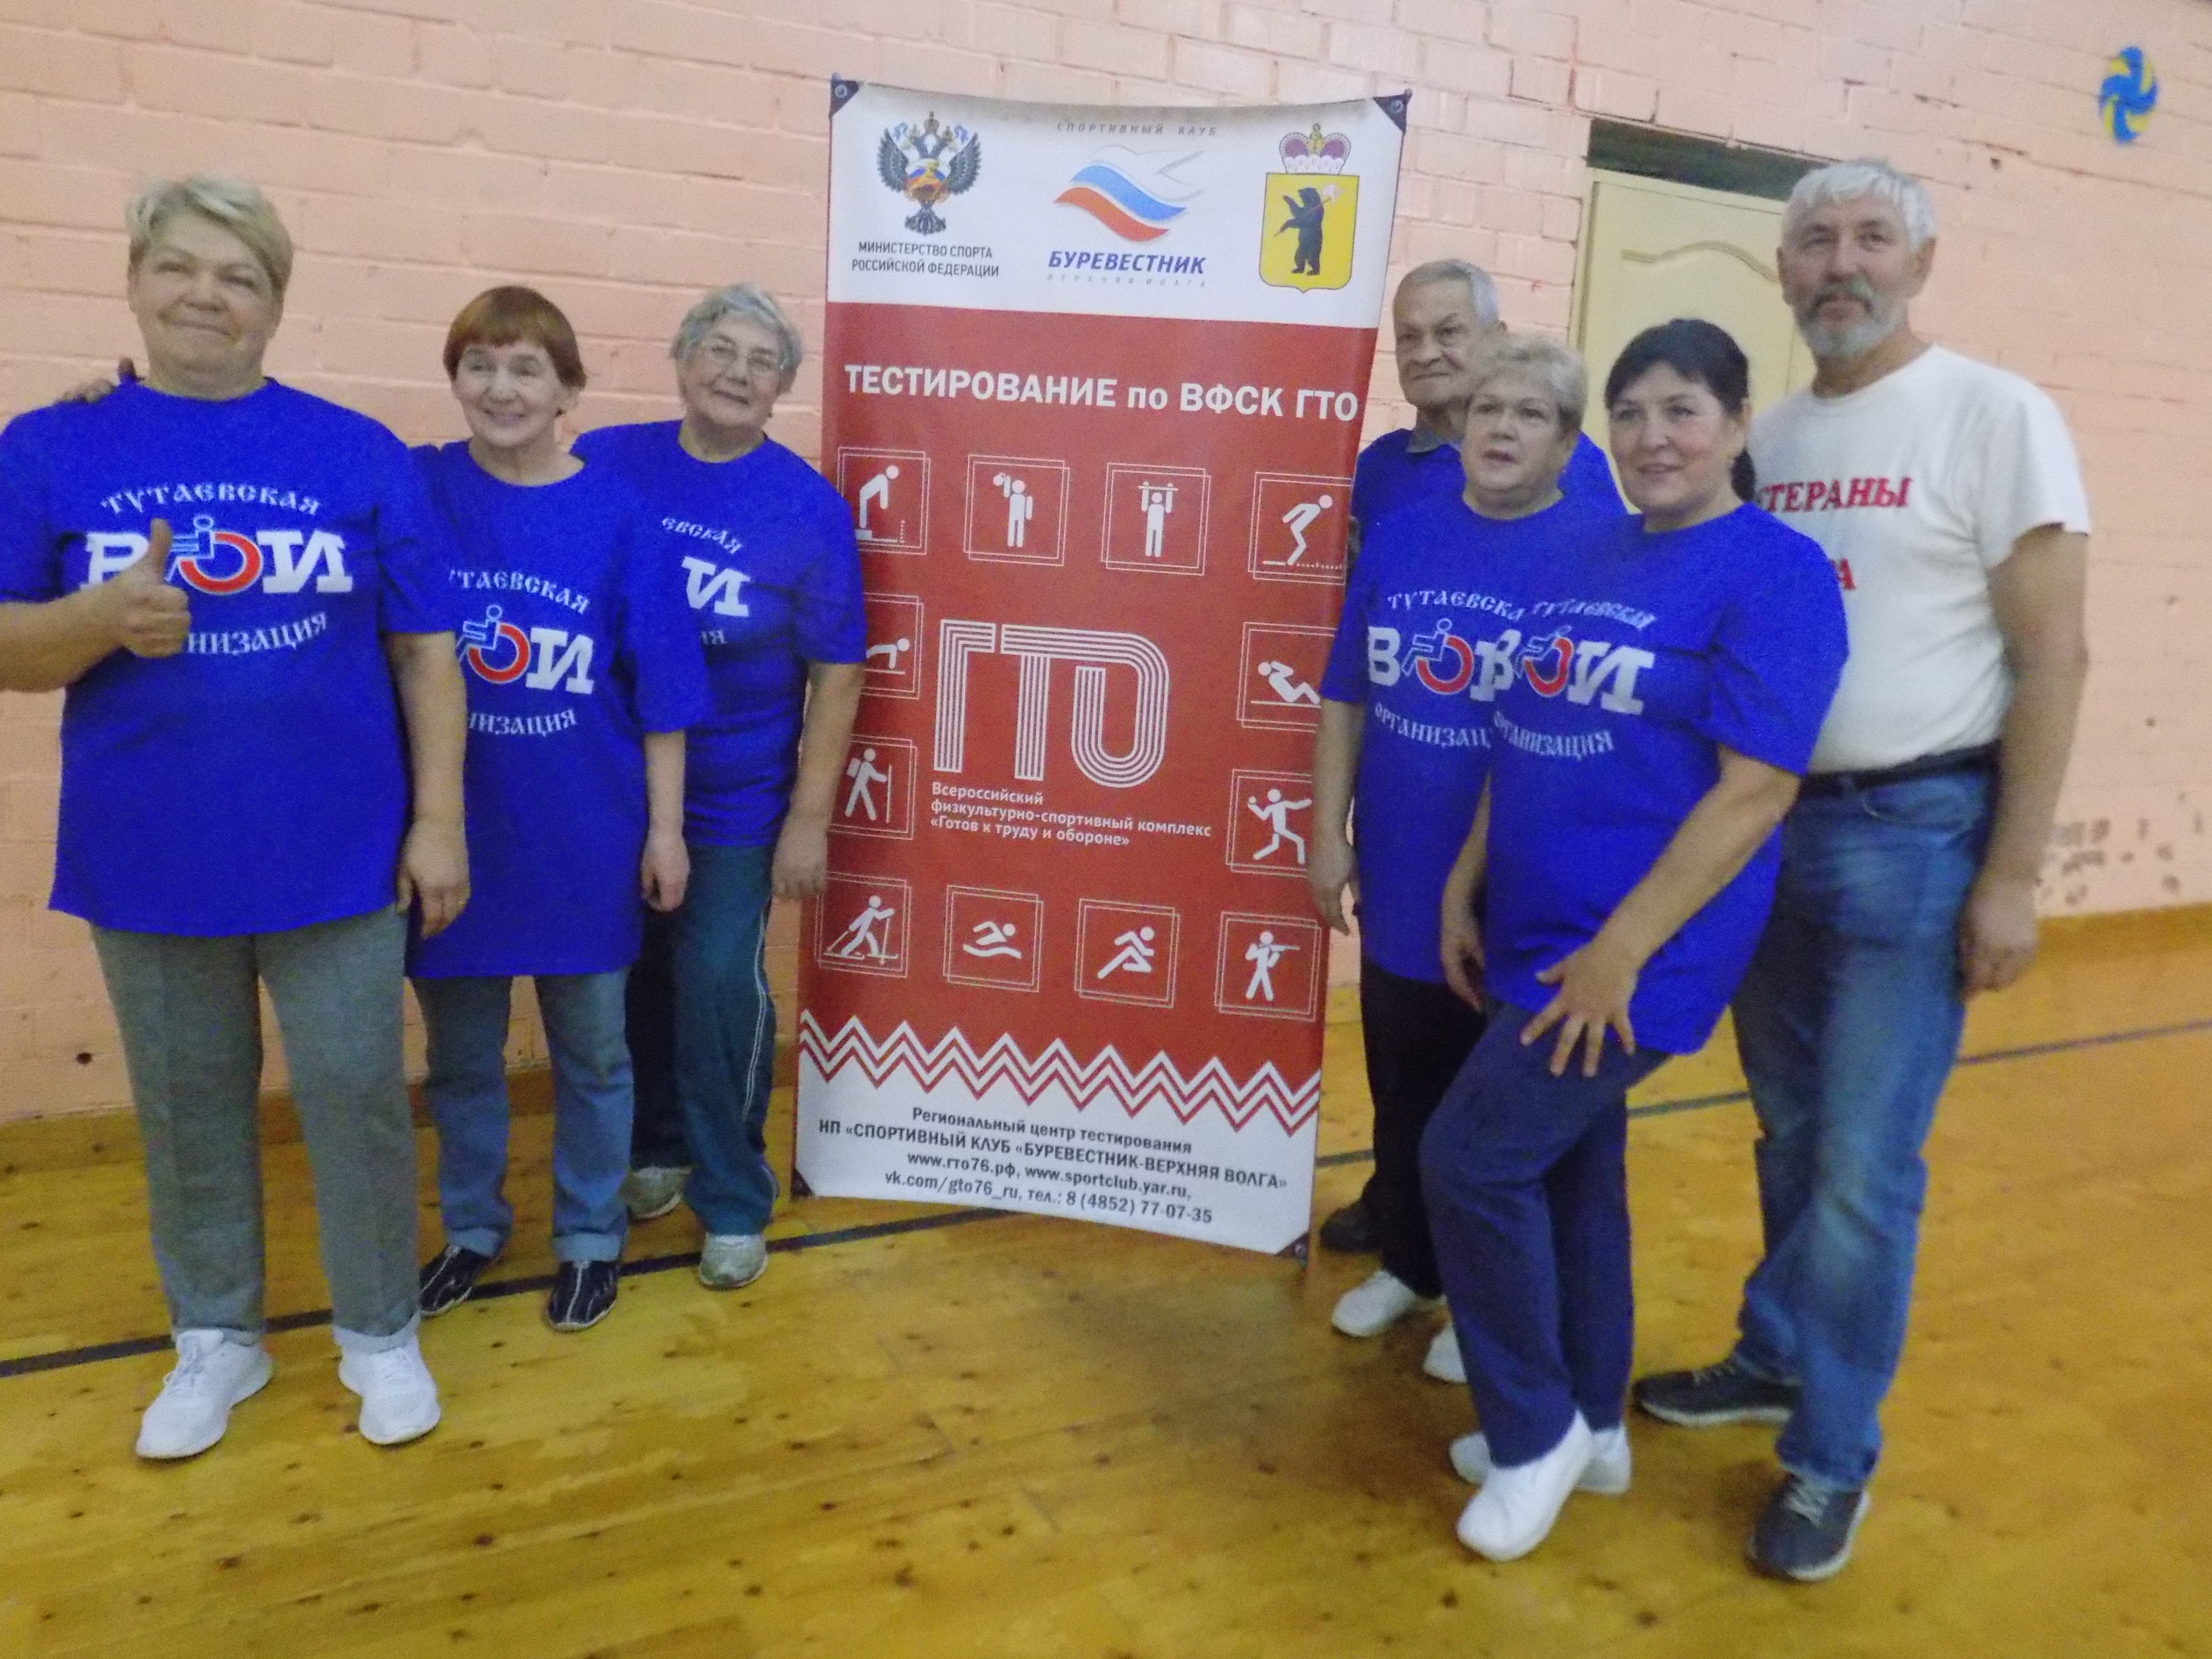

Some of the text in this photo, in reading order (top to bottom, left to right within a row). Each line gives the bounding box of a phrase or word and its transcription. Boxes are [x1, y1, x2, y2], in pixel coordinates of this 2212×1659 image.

[1178, 127, 1215, 135] КЛУБ
[852, 258, 999, 277] РОССИЙСКОЙ ФЕДЕРАЦИИ
[859, 242, 992, 258] МИНИСТЕРСТВО СПОРТА
[1048, 251, 1206, 274] БУРЕВЕСТНИК
[845, 365, 1358, 421] ТЕСТИРОВАНИЕ по ВФСК ГТО
[1762, 476, 1913, 513] ТЕРАНЫ
[449, 569, 591, 615] ТАЕВСКАЯ
[1387, 590, 1525, 621] ТУТАЕВСКА
[188, 612, 327, 656] НИЗАЦИЯ
[933, 619, 1170, 789] ГТО
[1375, 702, 1491, 750] ОРГАНИЗАЦ
[932, 781, 1043, 805] Всероссийский
[931, 799, 1212, 837] физкультурно-спортивный комплекс
[931, 815, 1130, 846] «Готов к труду и обороне»
[912, 1107, 1192, 1154] Региональный центр тестирования
[819, 1119, 1287, 1189] НП «СПОРТИВНЫЙ КЛУБ «БУРЕВЕСТНИК-ВЕРХНЯЯ ВОЛГА»
[885, 1170, 1023, 1202] vk.com/gto76_ru,
[1066, 1191, 1077, 1205] 8
[1080, 1193, 1135, 1216] (4852)
[1141, 1201, 1212, 1223] 77-07-35
[1024, 1166, 1192, 1201] www.sportclub.yar.ru,
